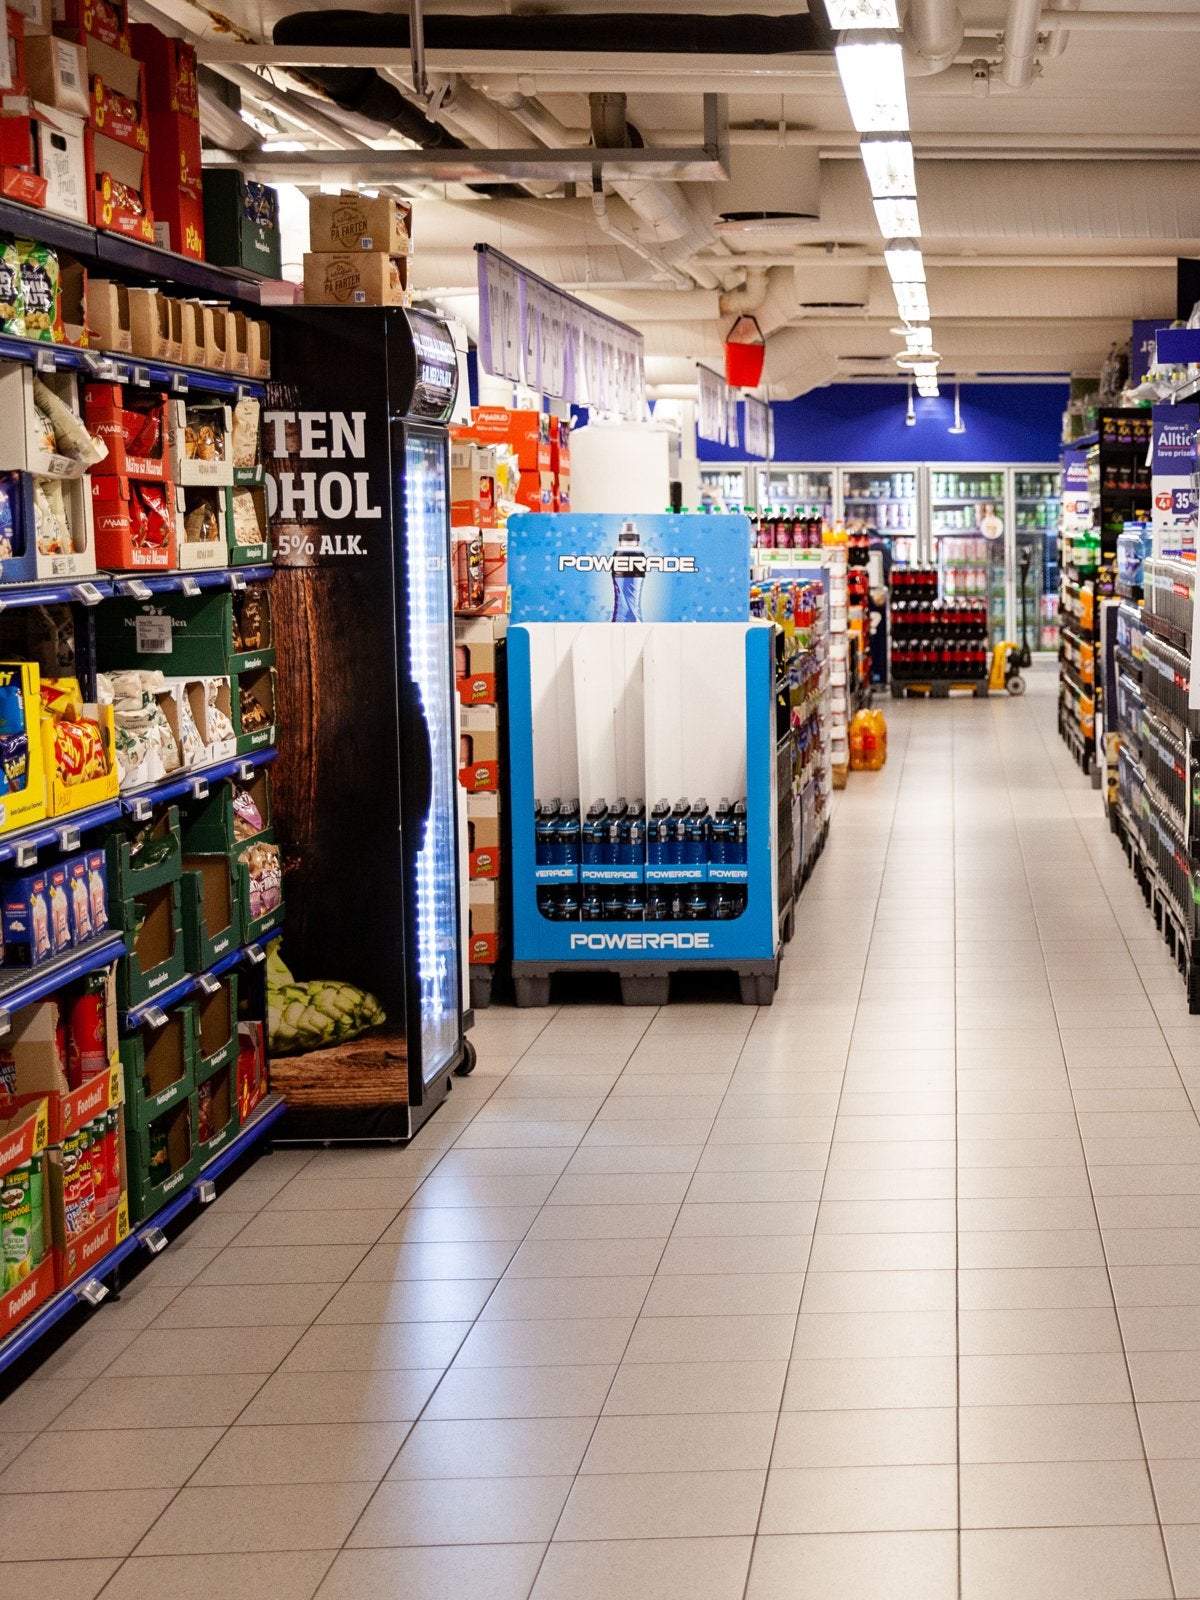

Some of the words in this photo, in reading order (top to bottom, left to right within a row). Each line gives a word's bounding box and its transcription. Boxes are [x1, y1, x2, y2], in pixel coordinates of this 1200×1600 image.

[264, 412, 367, 458] TEN
[1158, 449, 1173, 457] lave
[1159, 498, 1167, 509] 4
[319, 535, 368, 555] ALK.
[77, 1086, 103, 1116] Football
[82, 1230, 109, 1260] Football
[9, 1282, 37, 1318] Football
